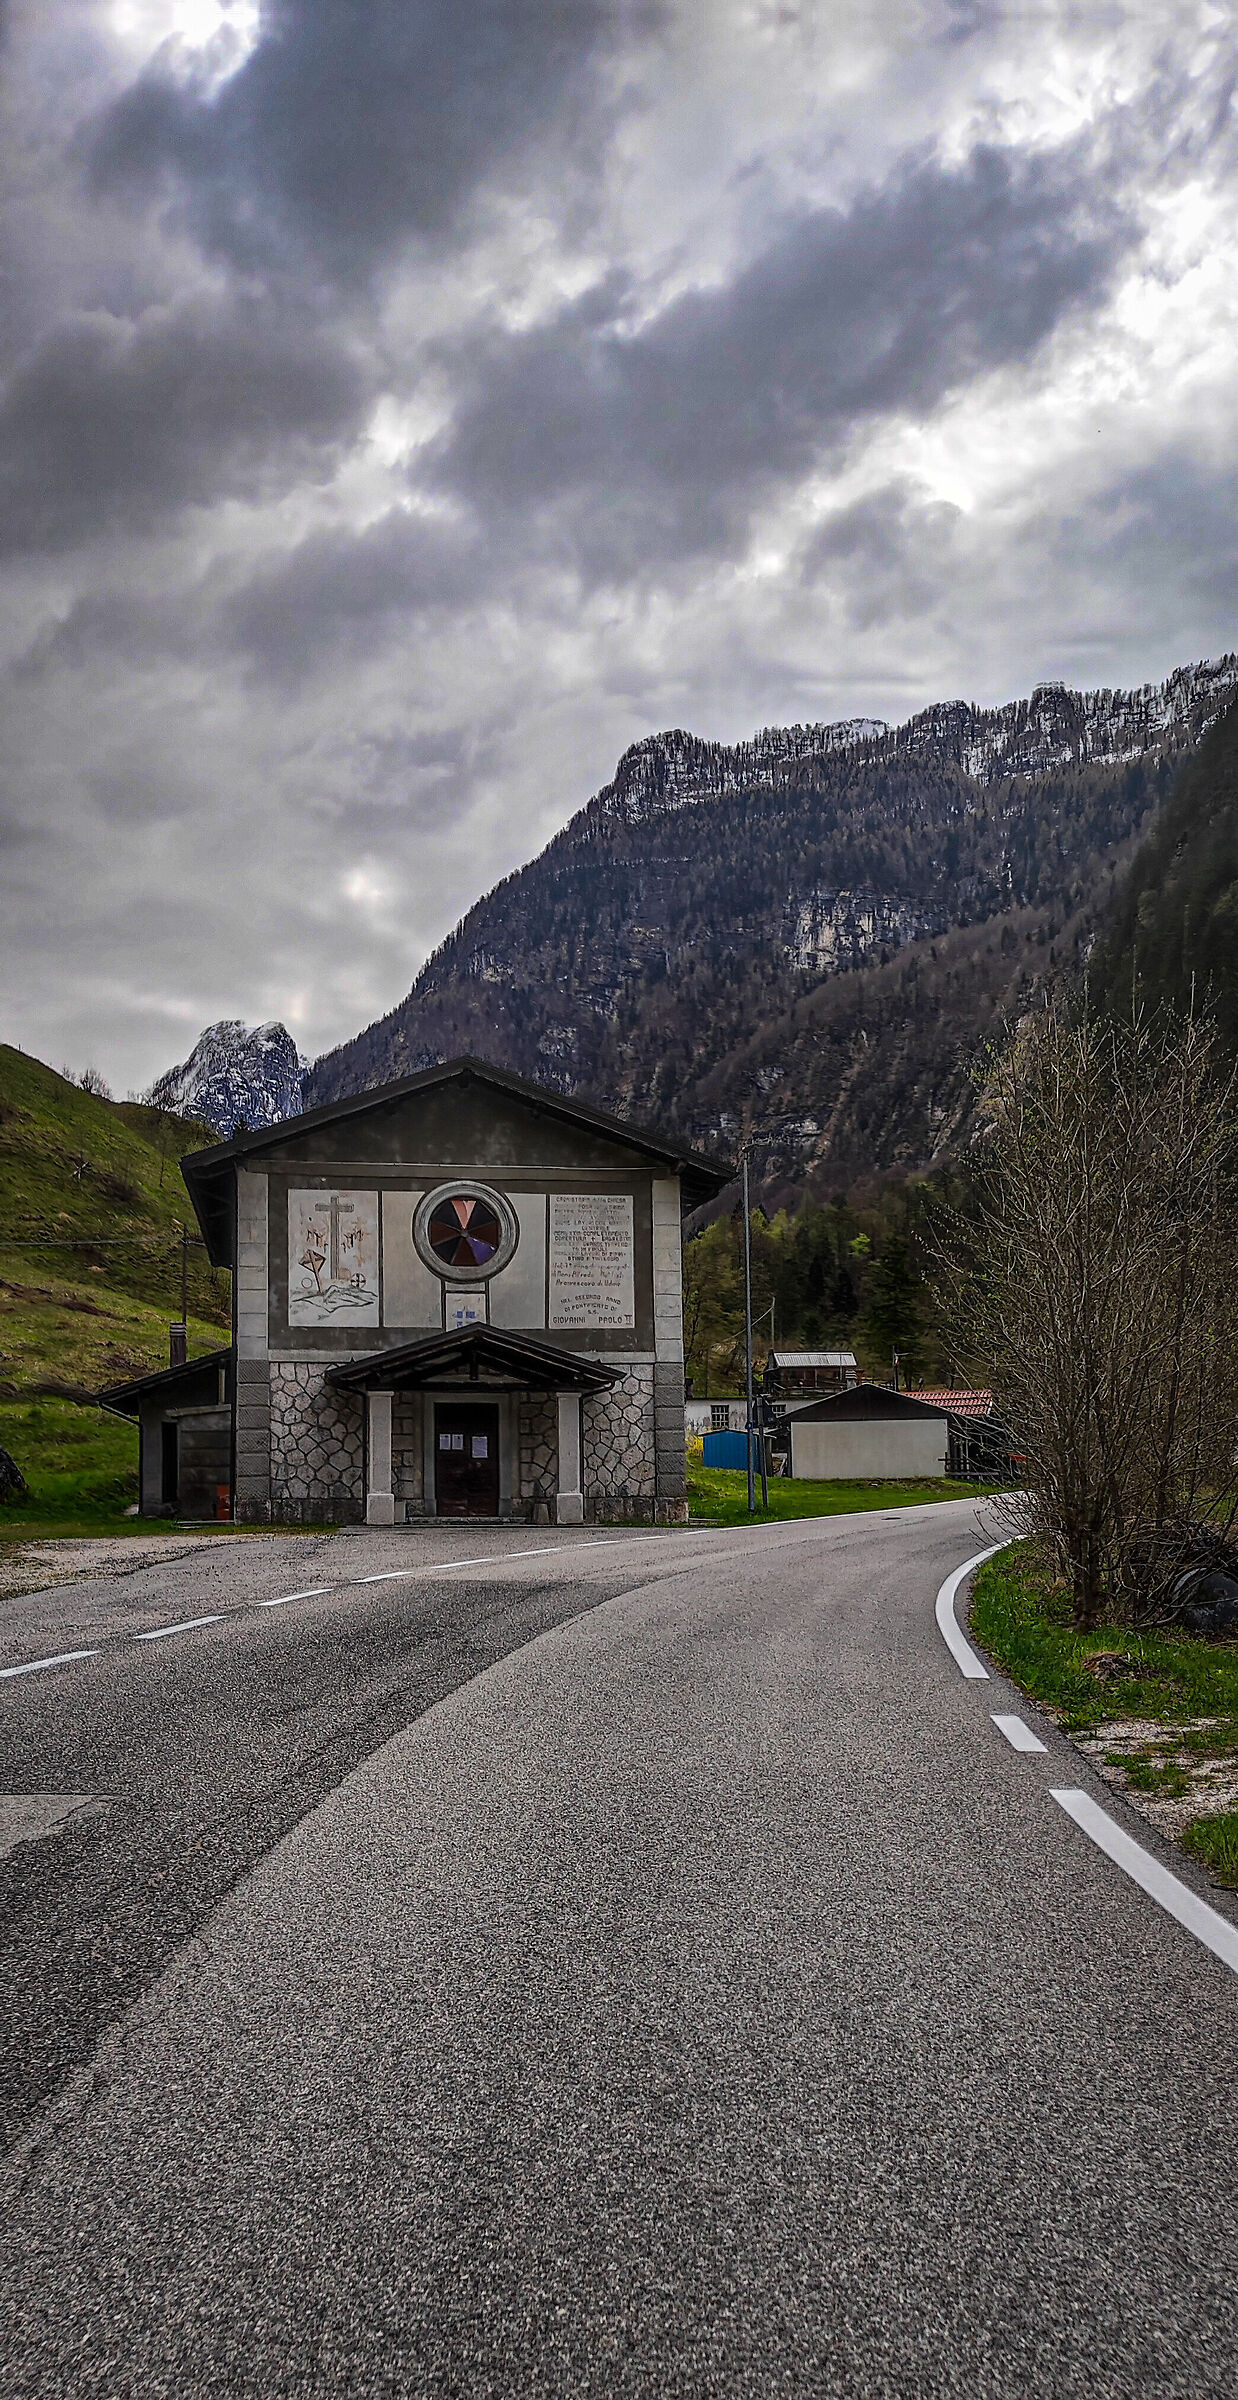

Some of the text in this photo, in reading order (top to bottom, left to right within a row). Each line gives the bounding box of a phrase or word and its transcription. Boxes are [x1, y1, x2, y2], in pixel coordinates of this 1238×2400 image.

[606, 1296, 621, 1305] ANNO
[552, 1316, 586, 1324] GIOVANNI
[598, 1316, 623, 1324] PAOLO
